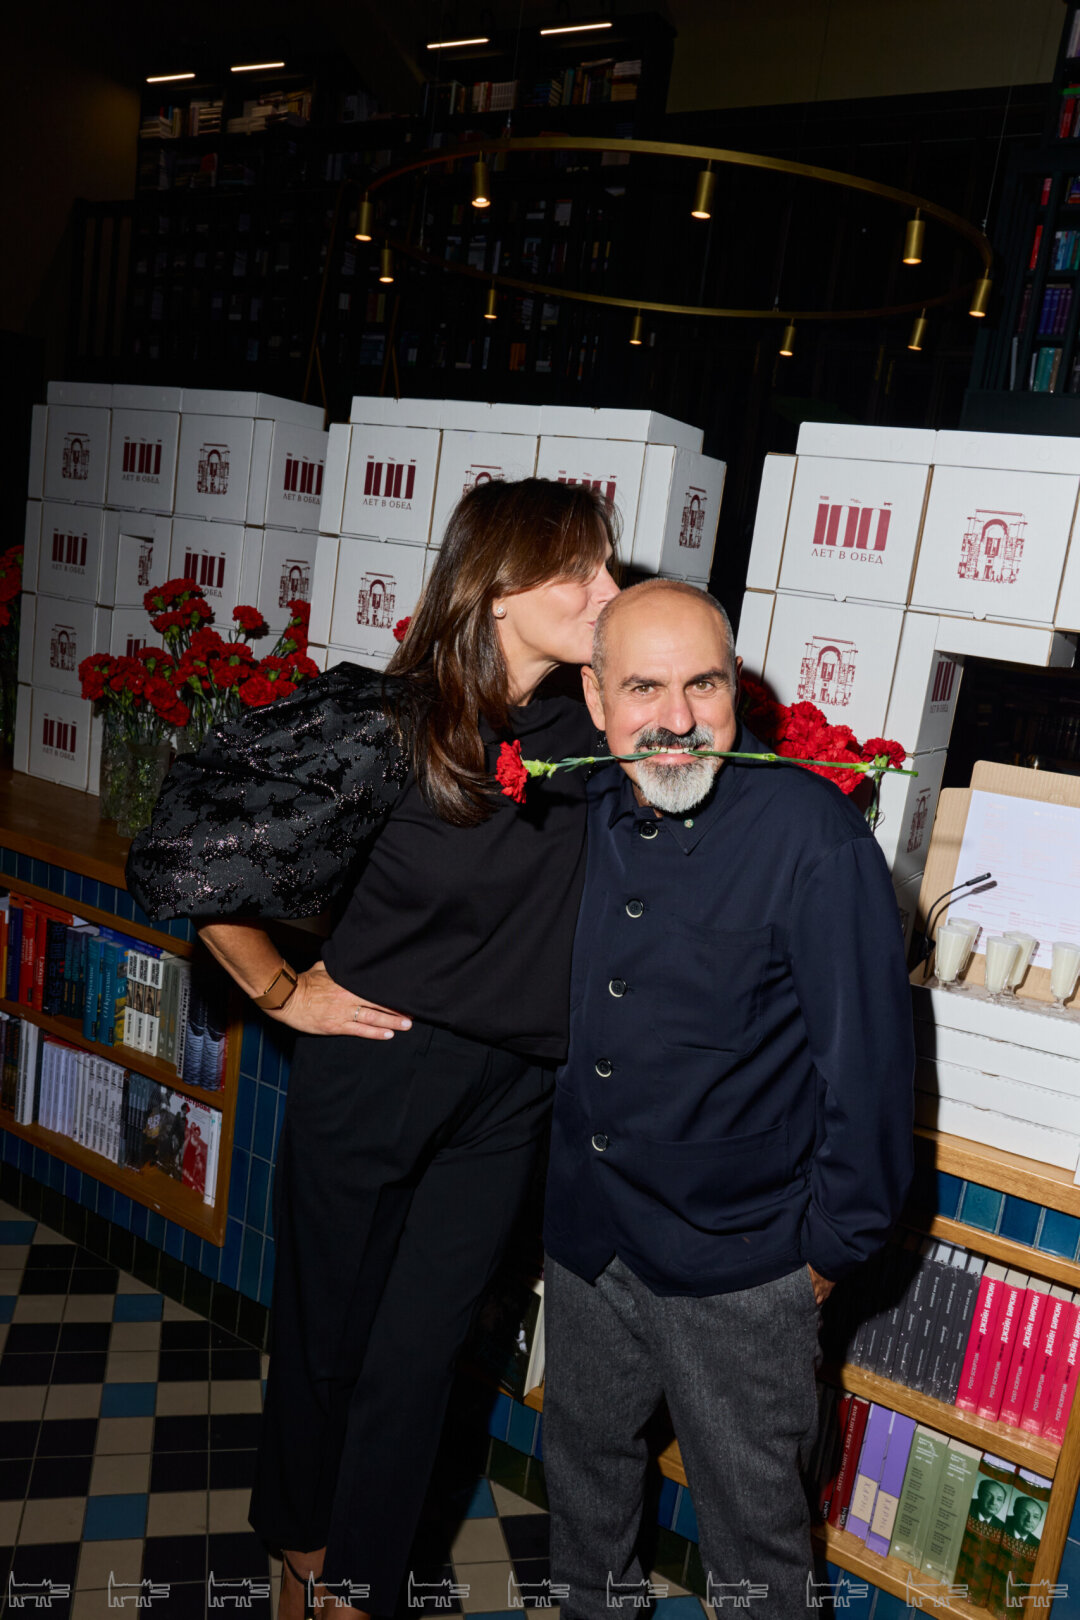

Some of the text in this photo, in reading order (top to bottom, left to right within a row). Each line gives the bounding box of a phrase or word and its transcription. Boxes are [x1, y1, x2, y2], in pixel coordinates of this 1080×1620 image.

[283, 493, 321, 505] ЛЕТ В ОБЕД
[363, 461, 416, 499] 100
[362, 498, 412, 510] ЛЕТ В ОБЕД
[812, 503, 892, 551] 100
[811, 547, 883, 565] ЛЕТ В ОБЕД
[979, 1281, 996, 1335] ДЖЕЙН БИРКИН
[1000, 1290, 1018, 1343] ДЖЕЙН БИРКИН
[1022, 1294, 1040, 1349] ДЖЕЙН БИРКИН
[1044, 1302, 1063, 1356] ДЖЕЙН БИРКИН
[967, 1352, 979, 1390] POST-SCRIPTUM
[1067, 1338, 1079, 1366] ДЖЕЙН
[988, 1361, 1001, 1398] POST-SCRIPTUM
[1010, 1366, 1023, 1403] POST-SCRIPTUM
[1032, 1374, 1045, 1412] POST-SCRIPTUM
[1055, 1383, 1067, 1421] POST-SCRIPTUM
